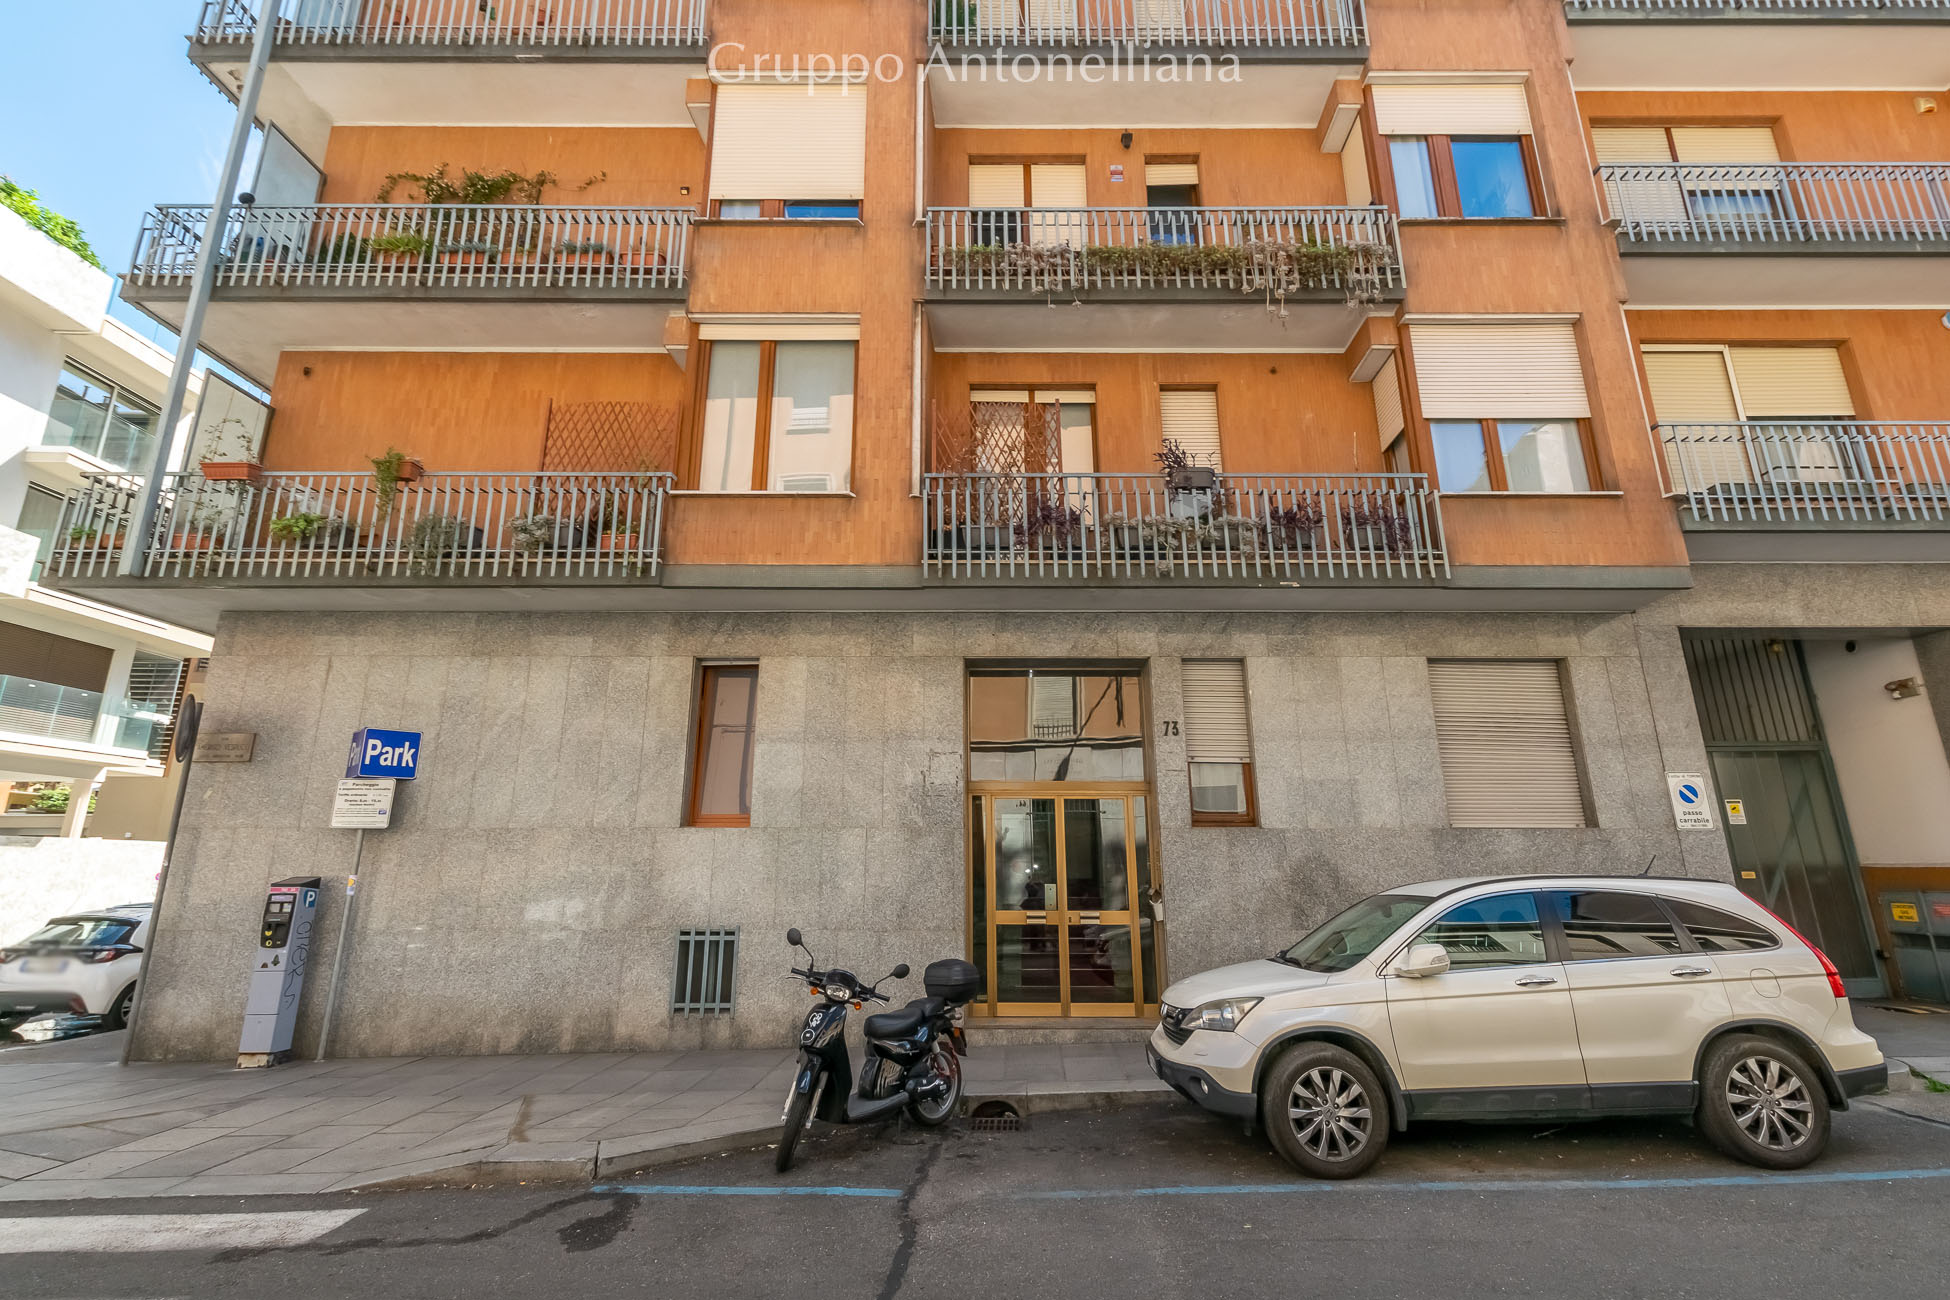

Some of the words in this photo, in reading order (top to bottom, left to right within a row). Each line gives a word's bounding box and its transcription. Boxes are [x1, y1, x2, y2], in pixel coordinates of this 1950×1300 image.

[1163, 720, 1179, 737] 73
[364, 738, 416, 768] Park
[1679, 816, 1710, 824] carrabile
